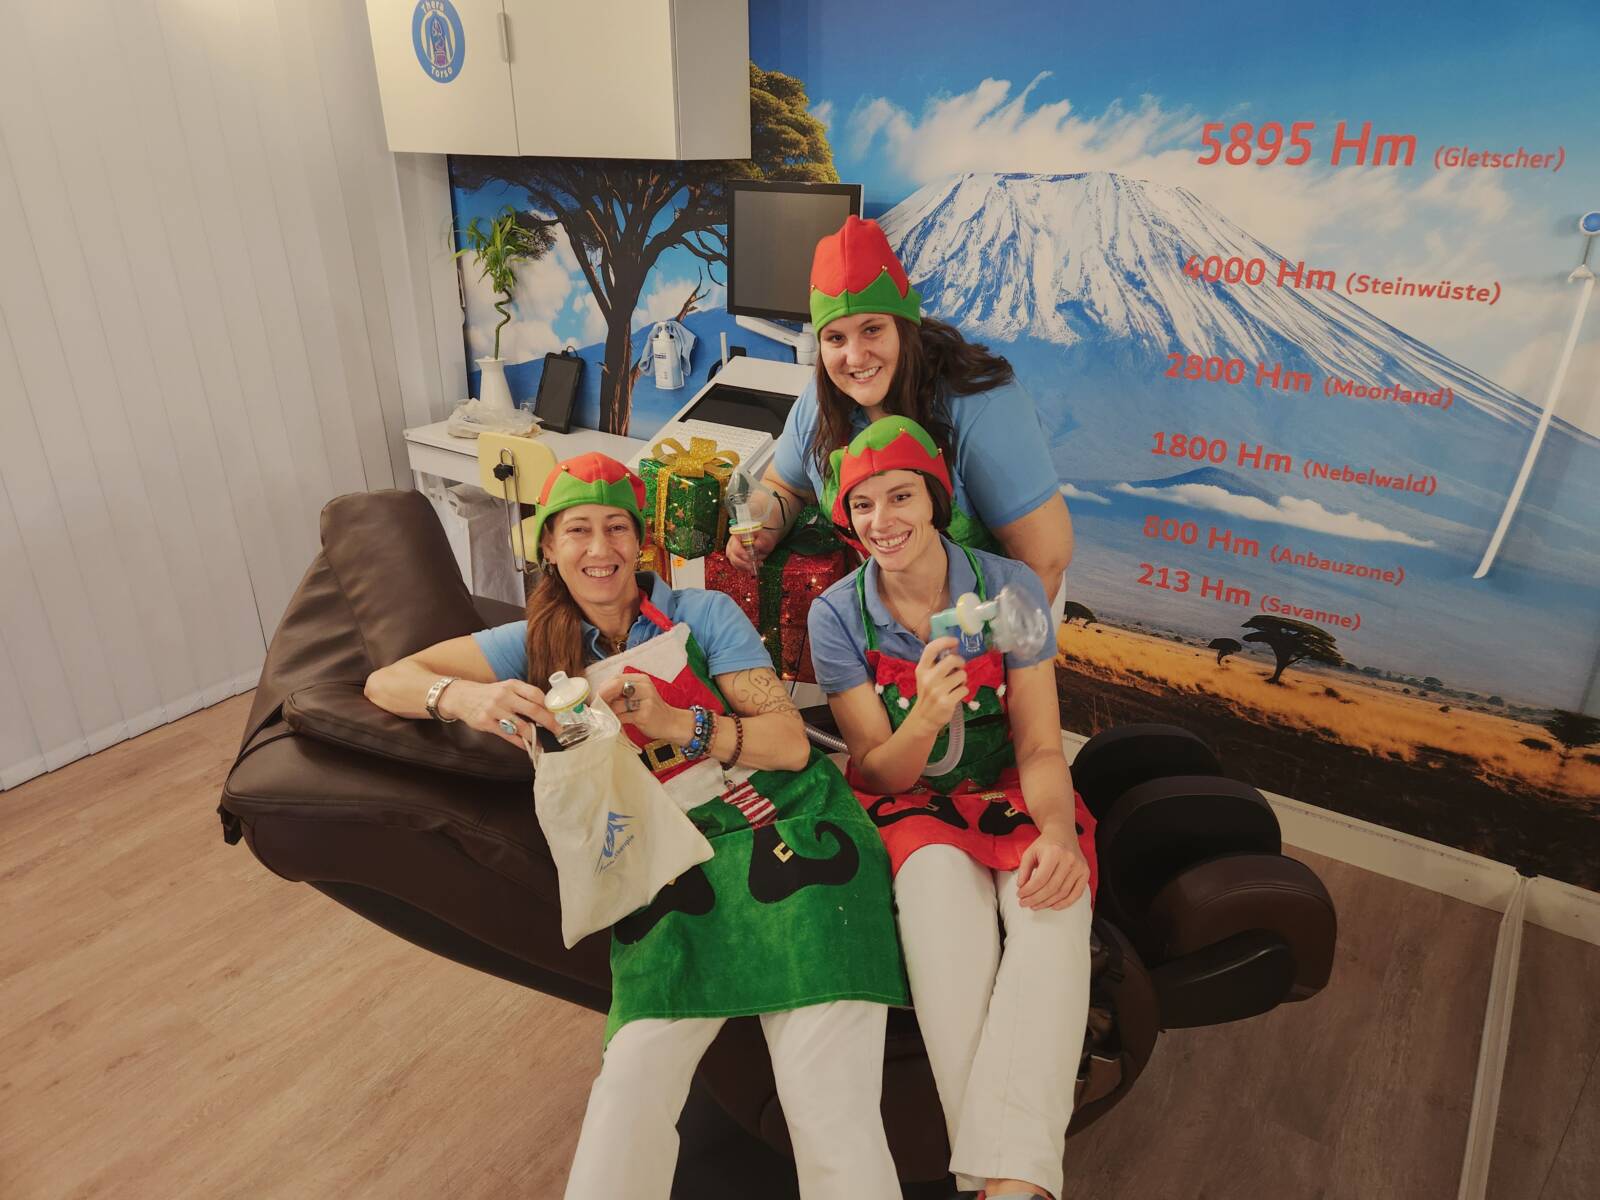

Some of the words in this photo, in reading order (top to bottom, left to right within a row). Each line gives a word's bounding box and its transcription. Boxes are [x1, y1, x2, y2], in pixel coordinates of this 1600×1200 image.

[1197, 121, 1316, 166] 5895
[1330, 121, 1417, 167] Hm
[1434, 146, 1566, 172] (Gletscher)
[1182, 255, 1266, 287] 4000
[1276, 260, 1337, 292] Hm
[1345, 272, 1502, 305] (Steinwüste)
[1164, 352, 1246, 385] 2800
[1255, 361, 1312, 393] Hm
[1323, 376, 1455, 411] (Moorland)
[1151, 431, 1228, 464] 1800
[1237, 441, 1292, 474] Hm
[1303, 459, 1438, 497] (Nebelwald)
[1142, 515, 1198, 545] 800
[1207, 527, 1260, 558] Hm
[1270, 544, 1405, 586] (Anbauzone)
[1136, 563, 1190, 593] 213
[1200, 576, 1251, 607] Hm
[1260, 595, 1361, 632] (Savanne)
